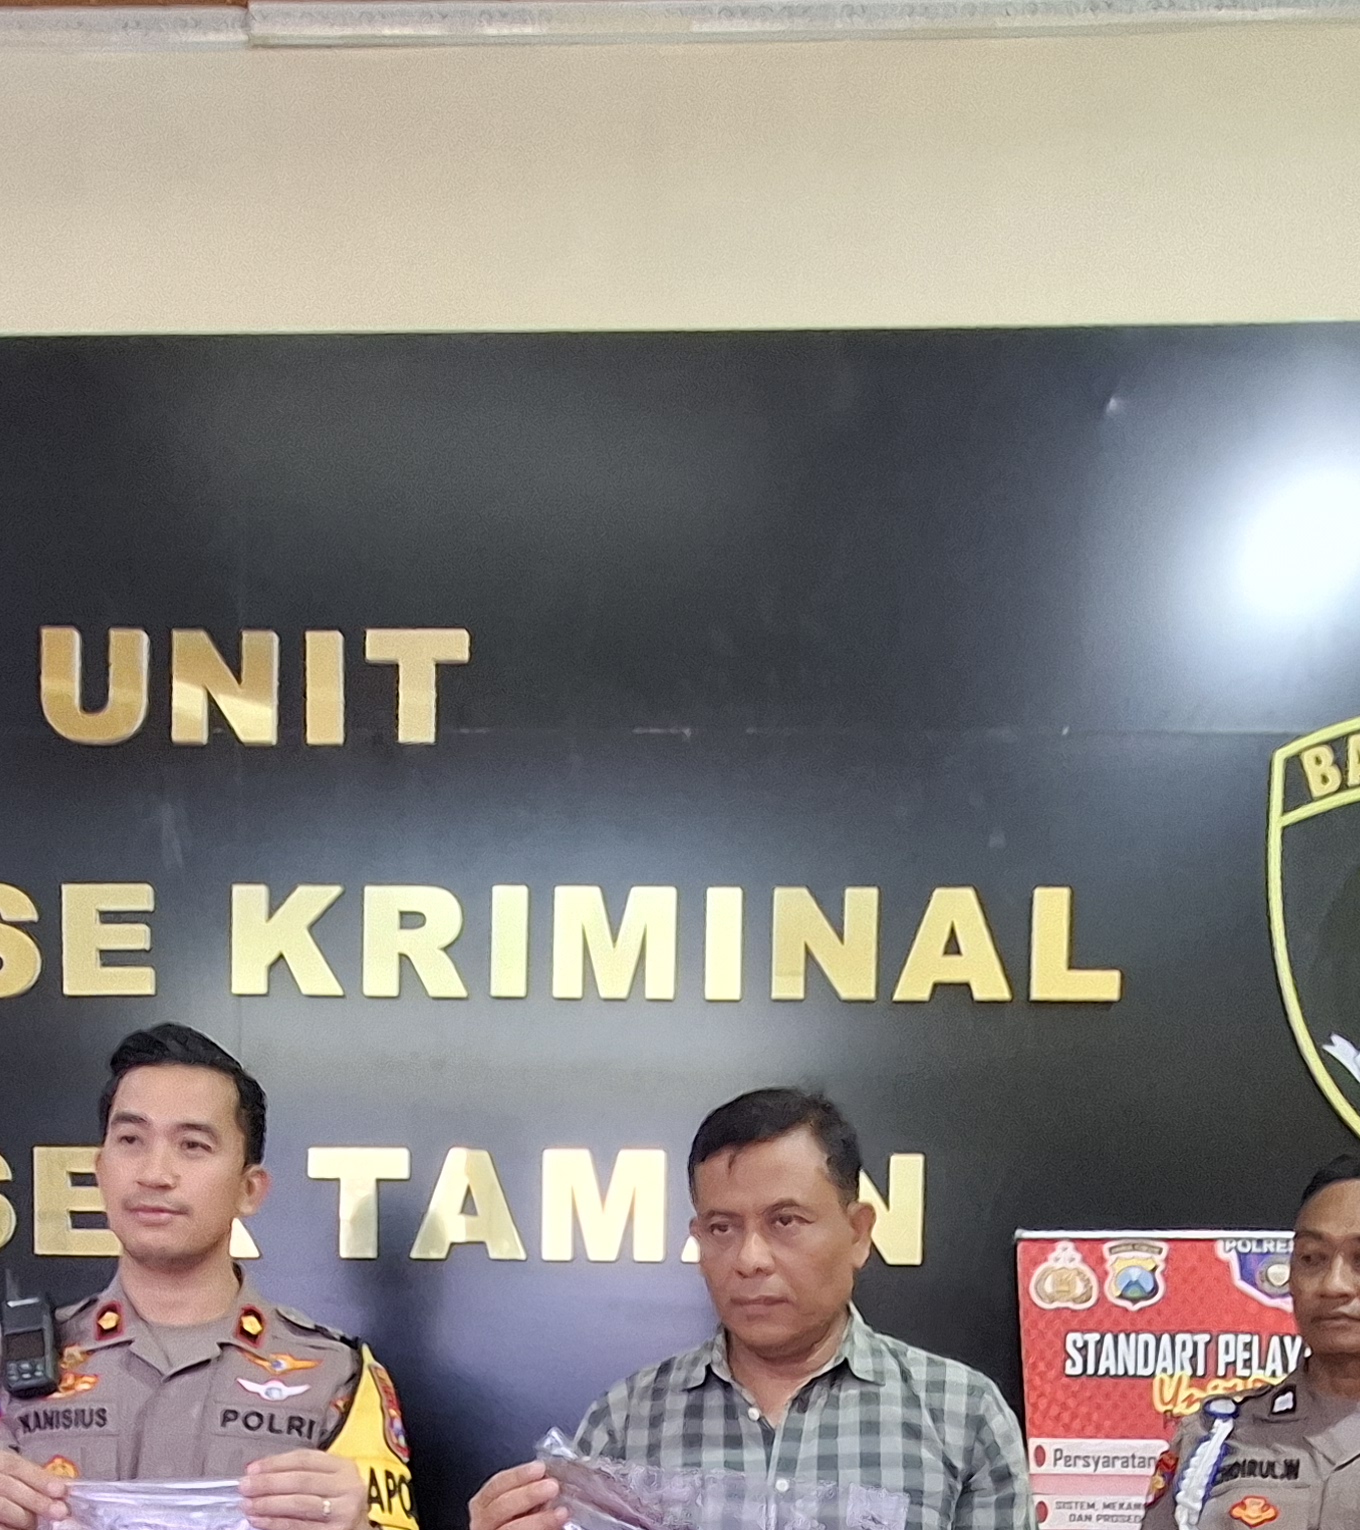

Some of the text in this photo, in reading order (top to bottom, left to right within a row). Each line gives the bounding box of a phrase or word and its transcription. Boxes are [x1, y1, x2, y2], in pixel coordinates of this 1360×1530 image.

[40, 626, 471, 747] UNIT
[228, 883, 1122, 1003] KRIMINAL
[307, 1145, 927, 1267] TAMN
[1064, 1332, 1312, 1378] STANDART PELAY
[220, 1408, 316, 1440] POLRI
